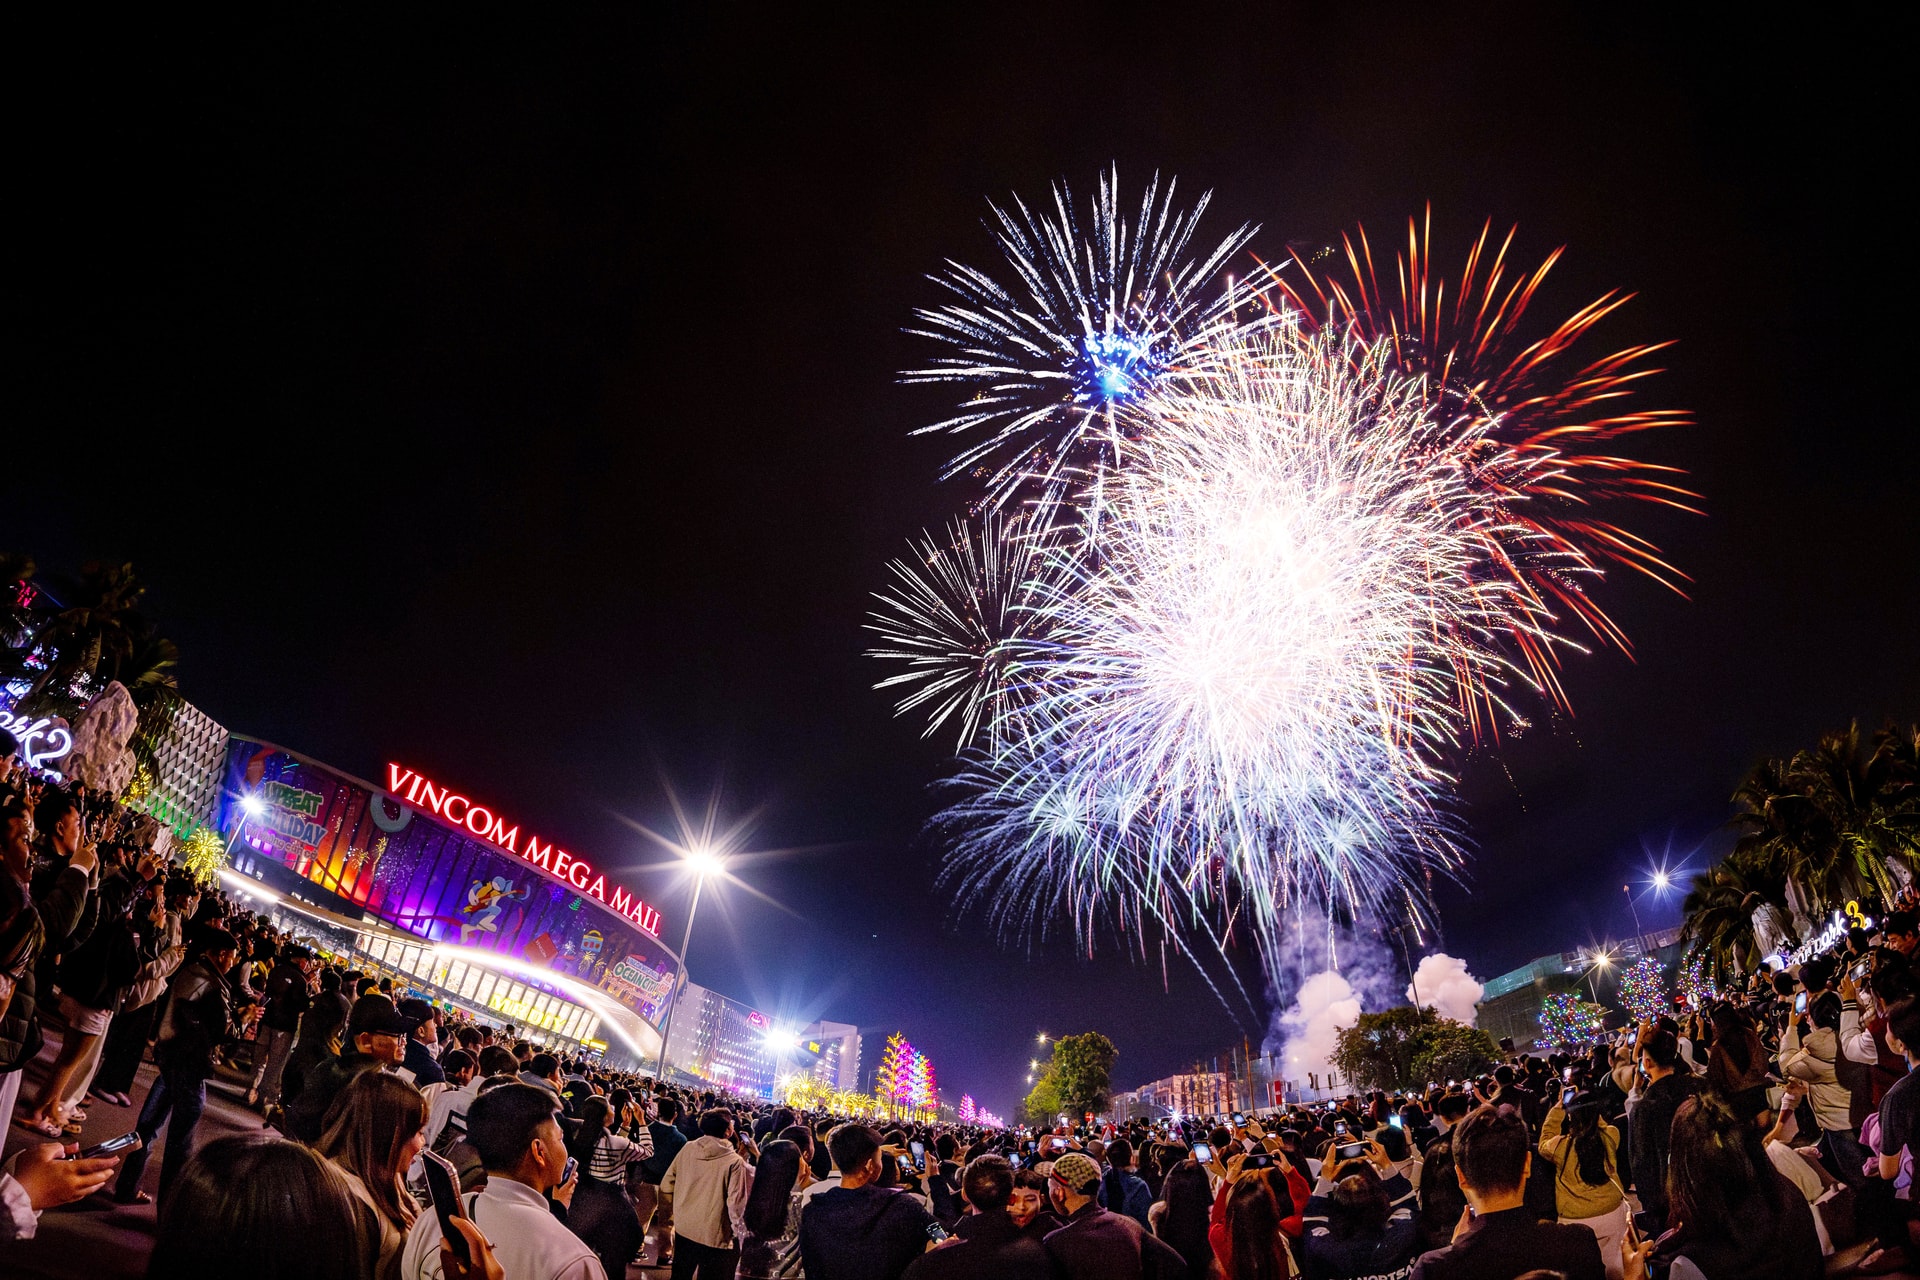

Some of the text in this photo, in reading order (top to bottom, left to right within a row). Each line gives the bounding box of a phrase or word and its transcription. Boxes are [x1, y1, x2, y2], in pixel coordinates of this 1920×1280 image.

[263, 780, 324, 818] UPBEAT
[388, 762, 662, 938] VINCOM MEGA MALL
